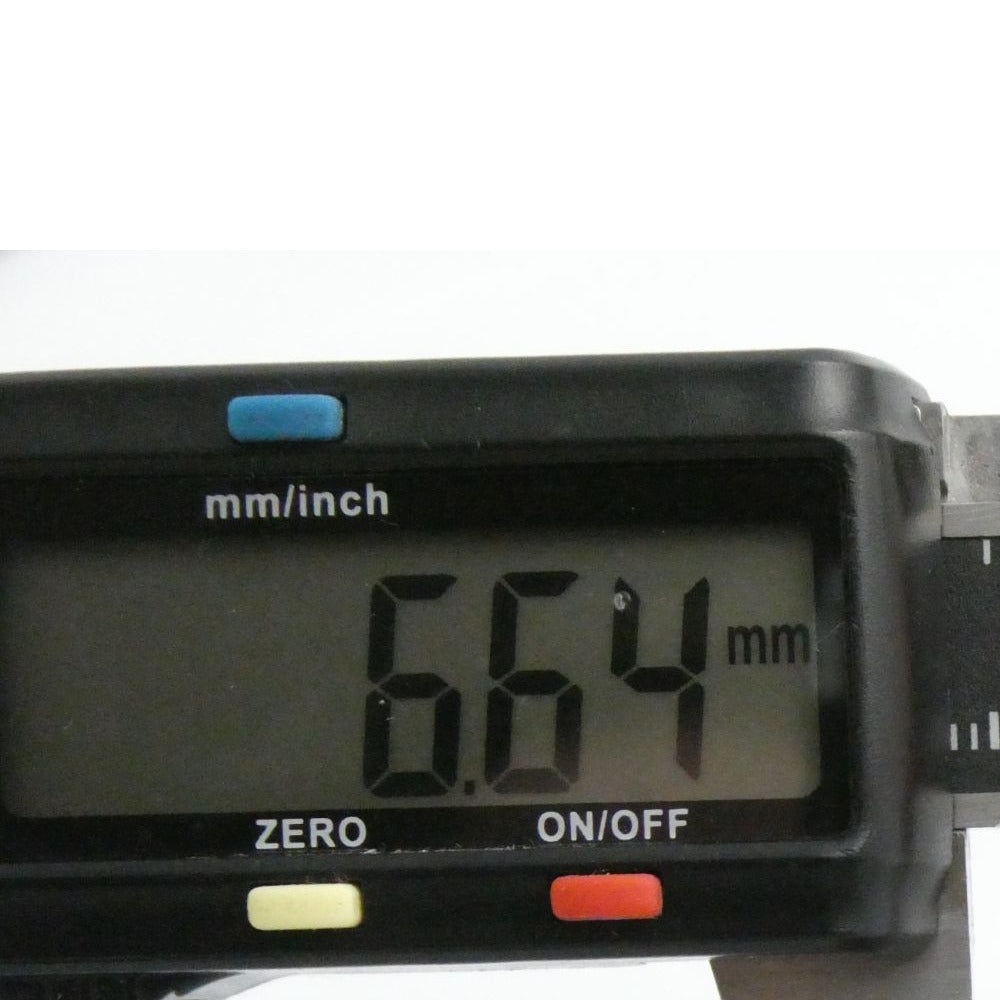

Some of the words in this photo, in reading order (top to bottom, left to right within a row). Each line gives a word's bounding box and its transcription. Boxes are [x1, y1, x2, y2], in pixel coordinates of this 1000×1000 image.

[206, 483, 389, 519] mm/inch
[363, 570, 711, 797] 6.64
[726, 622, 812, 667] mm
[255, 816, 367, 850] ZERO
[537, 808, 689, 843] ON/OFF
